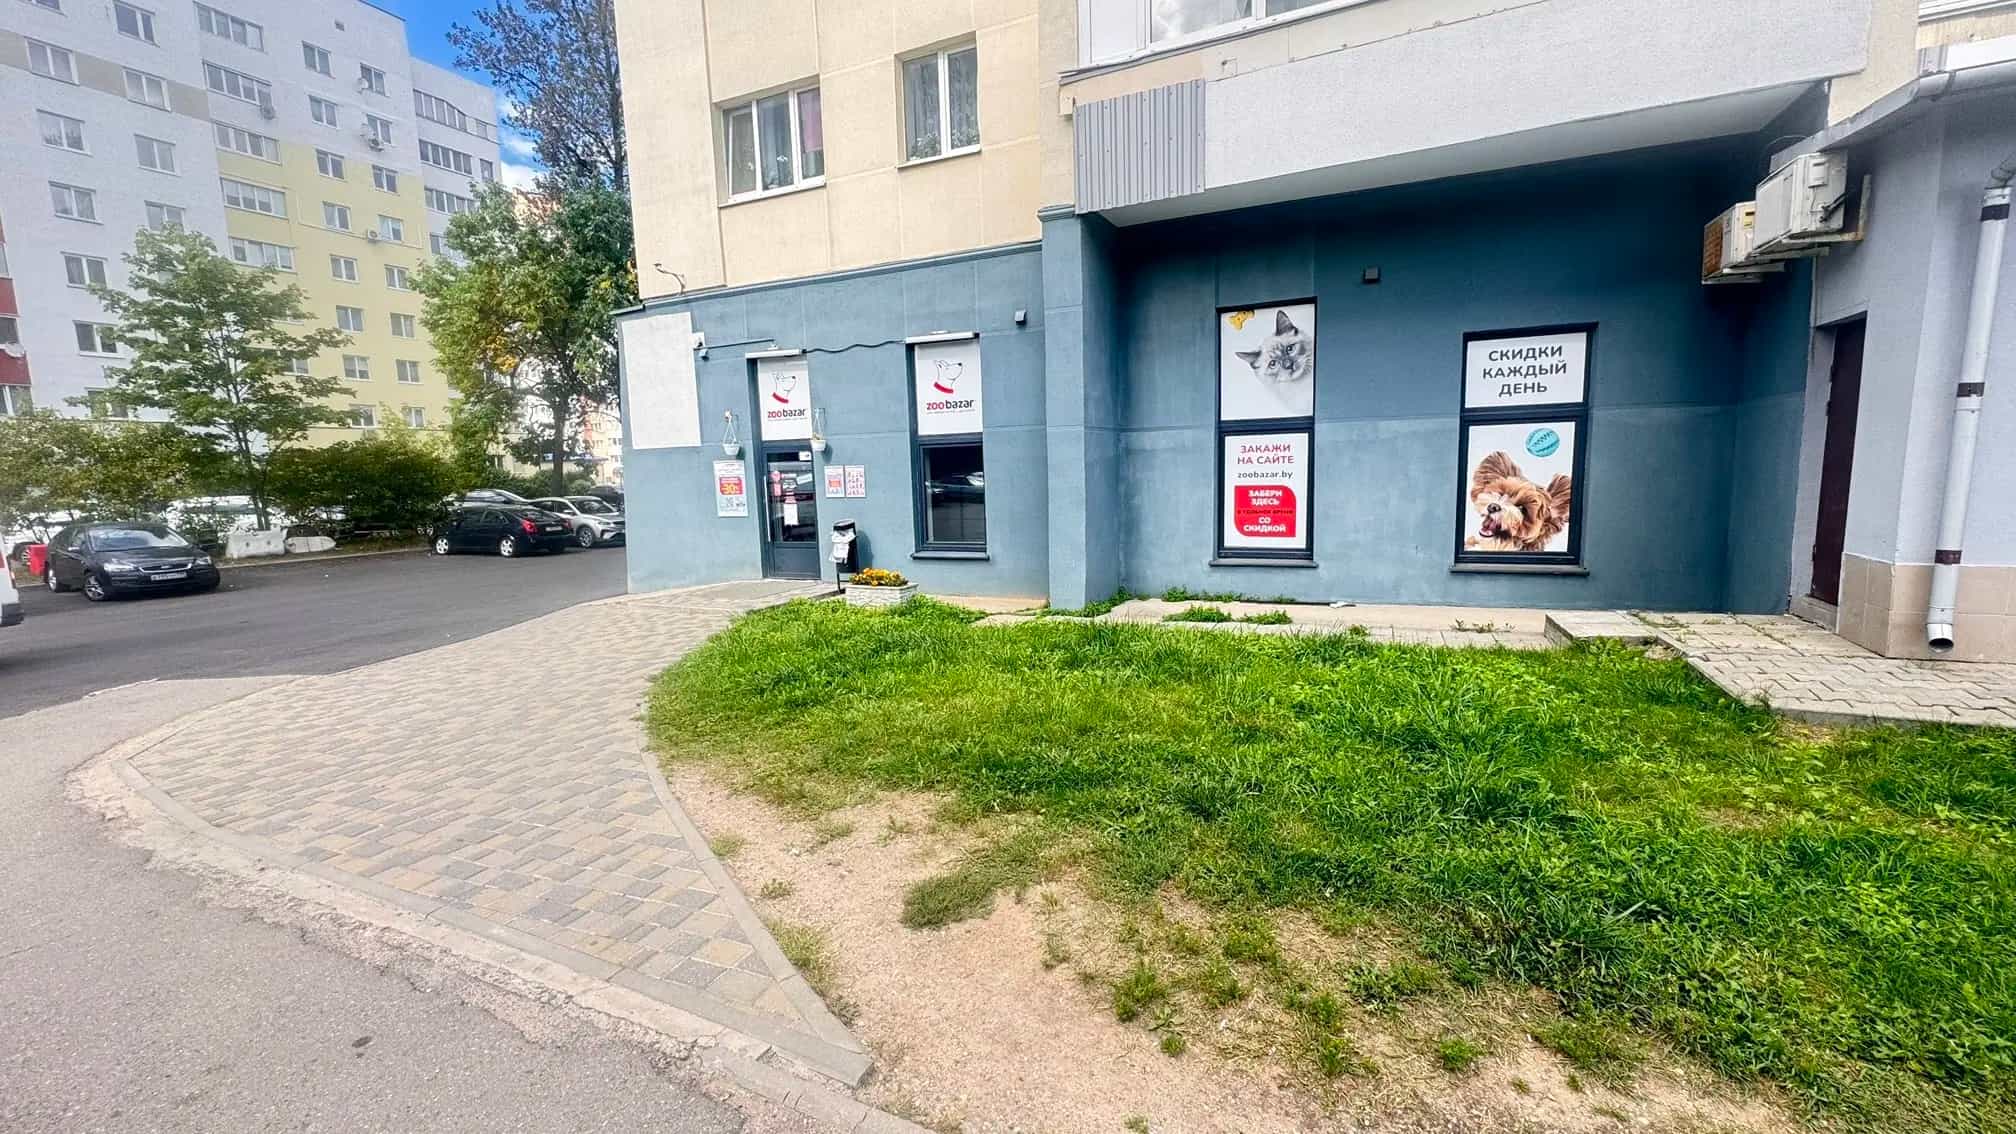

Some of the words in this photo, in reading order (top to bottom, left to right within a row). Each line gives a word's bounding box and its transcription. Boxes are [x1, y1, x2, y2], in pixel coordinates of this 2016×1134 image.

[1488, 345, 1563, 362] СКИДКИ
[1482, 360, 1567, 380] КАЖДЫЙ
[1498, 382, 1548, 398] ДЕНЬ
[926, 399, 975, 410] zoobazar
[767, 408, 807, 419] zoobazar
[1240, 444, 1291, 454] ЗАКАЖИ
[1237, 456, 1254, 465] НА
[1256, 453, 1295, 465] САЙТЕ
[1237, 470, 1294, 480] zoobazar.by
[1251, 498, 1280, 506] ЗДЕСЬ
[1243, 524, 1286, 532] СКИДКОЙ
